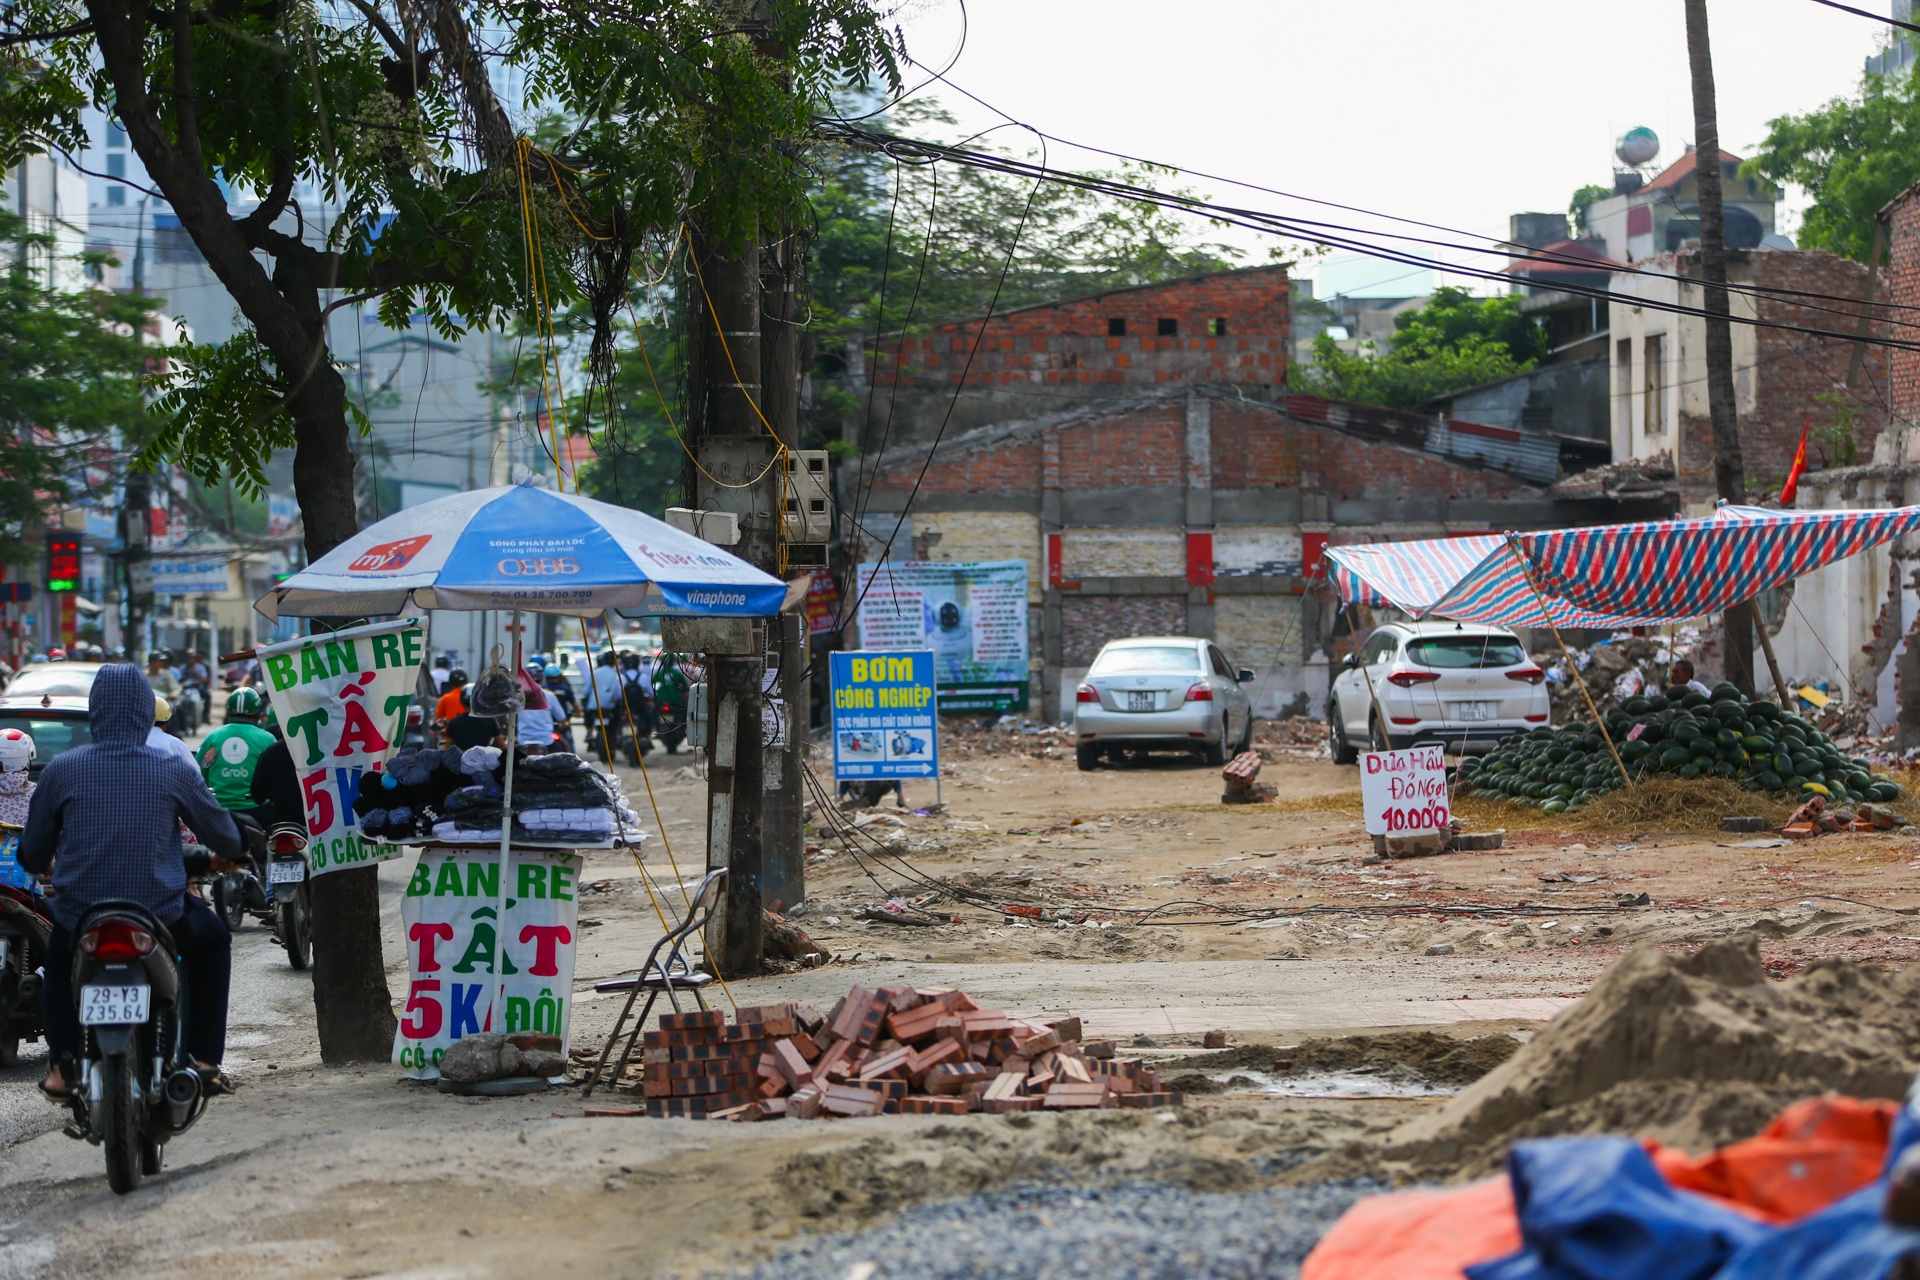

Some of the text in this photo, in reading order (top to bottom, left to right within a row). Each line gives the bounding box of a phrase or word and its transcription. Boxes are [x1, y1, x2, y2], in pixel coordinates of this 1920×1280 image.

[497, 557, 581, 576] 0886
[548, 590, 569, 599] 700
[572, 590, 593, 599] 700
[686, 589, 747, 608] vinaphone
[266, 617, 423, 692] BÁN RẺ
[851, 656, 914, 683] BƠM
[835, 683, 932, 712] CÔNG NGHIỆP
[286, 671, 414, 767] TẤT
[1409, 745, 1446, 771] Hấu
[221, 766, 249, 778] Grab
[1386, 771, 1416, 800] Đỏ
[1381, 805, 1448, 831] 10.000
[311, 837, 327, 871] CÓ
[331, 831, 367, 865] CÁC
[271, 872, 303, 883] 234.05
[407, 853, 575, 901] BÁN RẺ
[409, 898, 571, 977] TẤT
[92, 987, 139, 1003] 29-Y3
[85, 1005, 143, 1021] 235.64
[400, 1042, 426, 1070] CÓ
